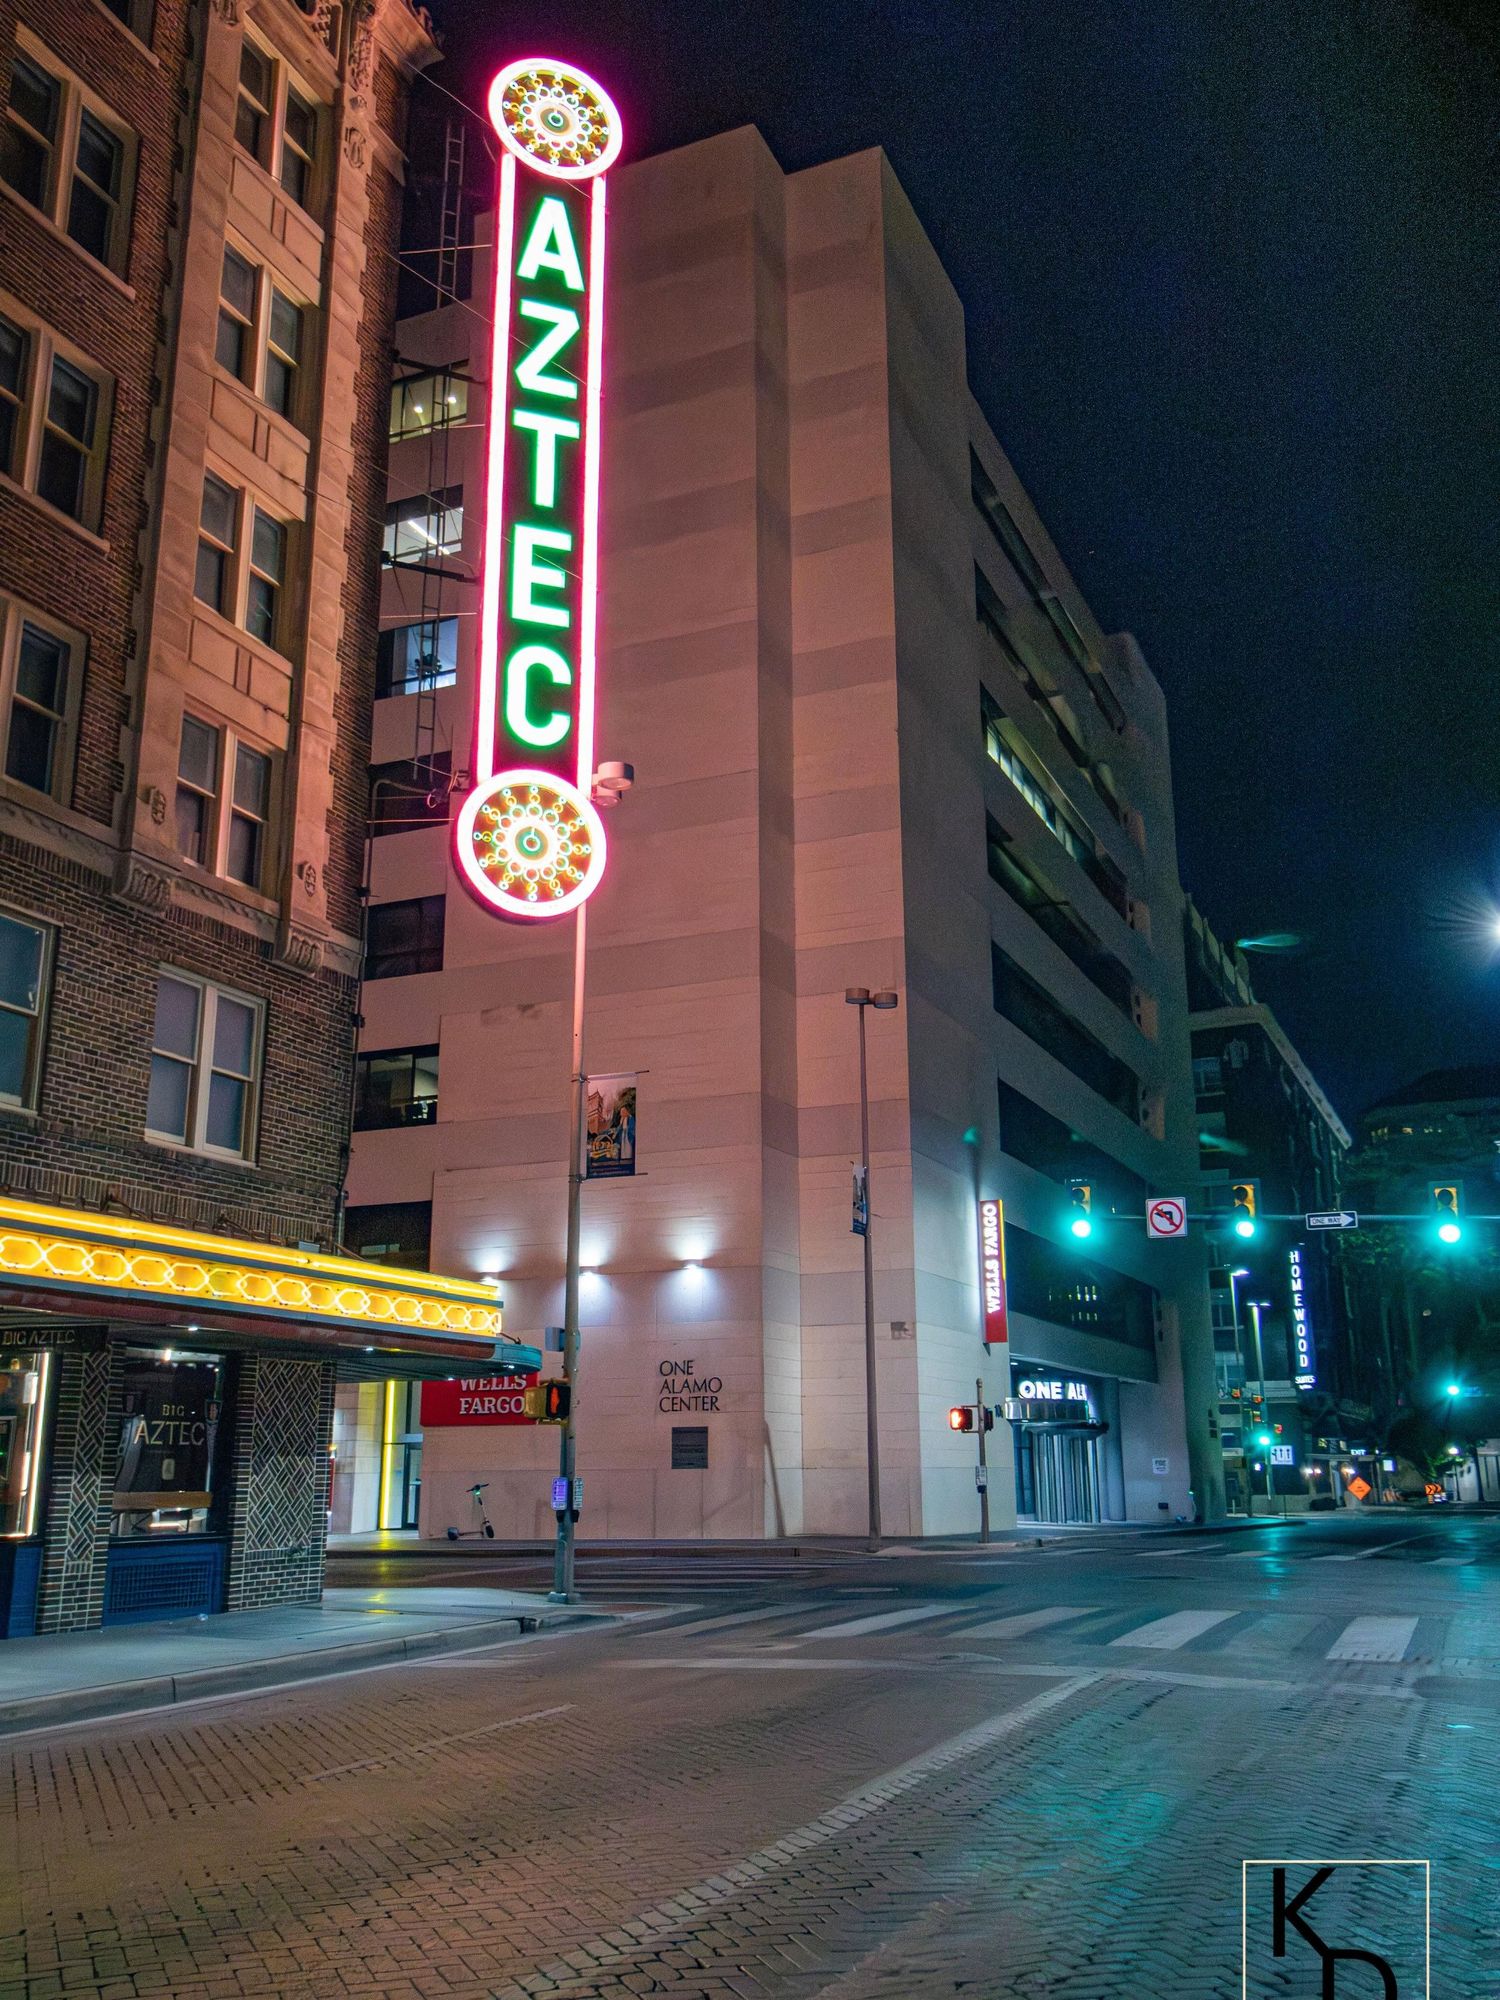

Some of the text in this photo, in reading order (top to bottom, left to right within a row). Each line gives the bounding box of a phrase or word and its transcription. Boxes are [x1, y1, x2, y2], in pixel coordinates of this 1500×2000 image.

[504, 196, 585, 748] AZTEC
[1311, 1216, 1341, 1225] ONE WAY
[982, 1202, 1001, 1314] WELLS FARGO
[1290, 1250, 1308, 1368] HOMEWOOD
[2, 1330, 76, 1345] BIG AZTEC
[660, 1360, 694, 1376] ONE
[460, 1374, 527, 1391] WELLS
[660, 1376, 722, 1394] ALAMO
[1019, 1381, 1062, 1399] ONE
[162, 1404, 185, 1416] BIG
[459, 1396, 525, 1415] FARGO
[660, 1395, 720, 1412] CENTER
[133, 1420, 205, 1446] AZTEC
